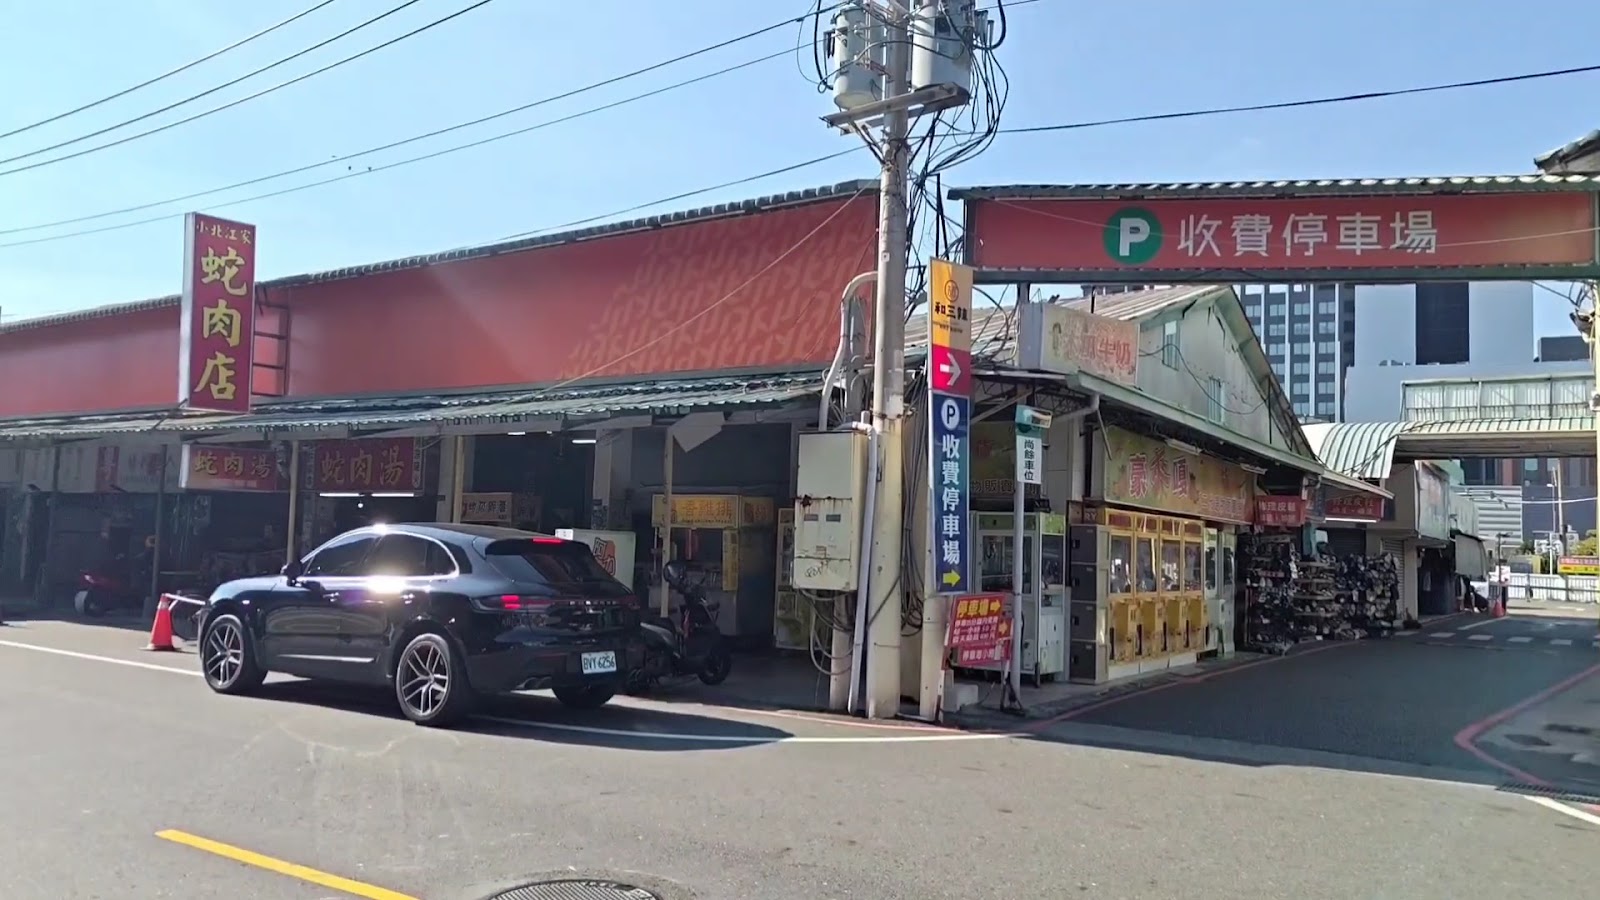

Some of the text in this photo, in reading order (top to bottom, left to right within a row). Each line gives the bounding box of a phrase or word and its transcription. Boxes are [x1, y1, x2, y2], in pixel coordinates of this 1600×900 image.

[196, 221, 252, 244] 小北江家
[1118, 219, 1149, 256] P
[1177, 210, 1439, 257] 收費停車場
[194, 246, 248, 401] 蛇肉店
[945, 405, 957, 424] P
[193, 449, 273, 479] 蛇肉湯
[320, 445, 405, 486] 蛇肉湯
[1023, 438, 1035, 482] 尚餘車位
[941, 433, 961, 566] 收費停車場
